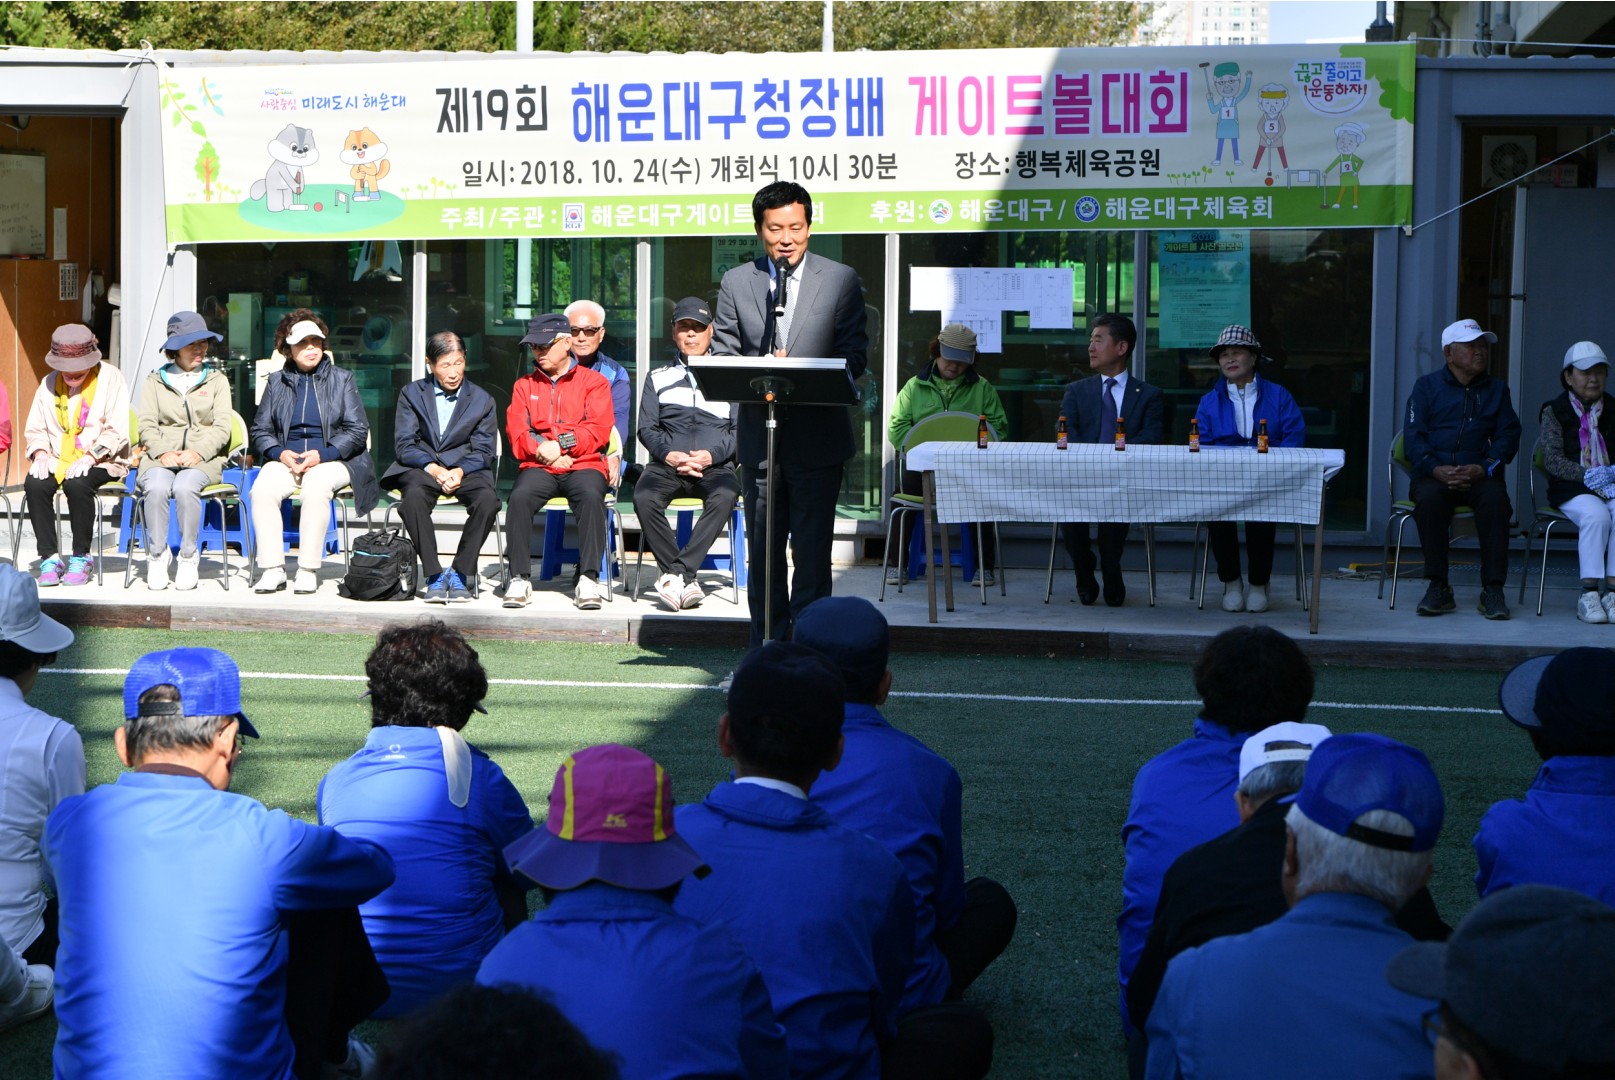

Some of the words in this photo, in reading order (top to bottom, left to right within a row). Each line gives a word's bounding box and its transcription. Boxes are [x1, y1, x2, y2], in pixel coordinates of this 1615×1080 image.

[1324, 62, 1362, 82] 줄이고
[260, 97, 297, 111] 사람중심
[302, 95, 358, 110] 미래도시
[362, 92, 406, 111] 해운대
[1308, 78, 1363, 102] 운동하자
[435, 85, 548, 134] 제19회
[571, 76, 884, 143] 해운대구청장배
[908, 70, 1188, 136] 게이트볼대회
[1269, 122, 1275, 131] 5
[592, 159, 623, 184] 10.
[633, 156, 701, 185] 24(수)
[710, 153, 780, 183] 개회식
[789, 152, 839, 181] 10시
[848, 152, 898, 180] 30분
[1105, 195, 1273, 221] 해운대구체육회
